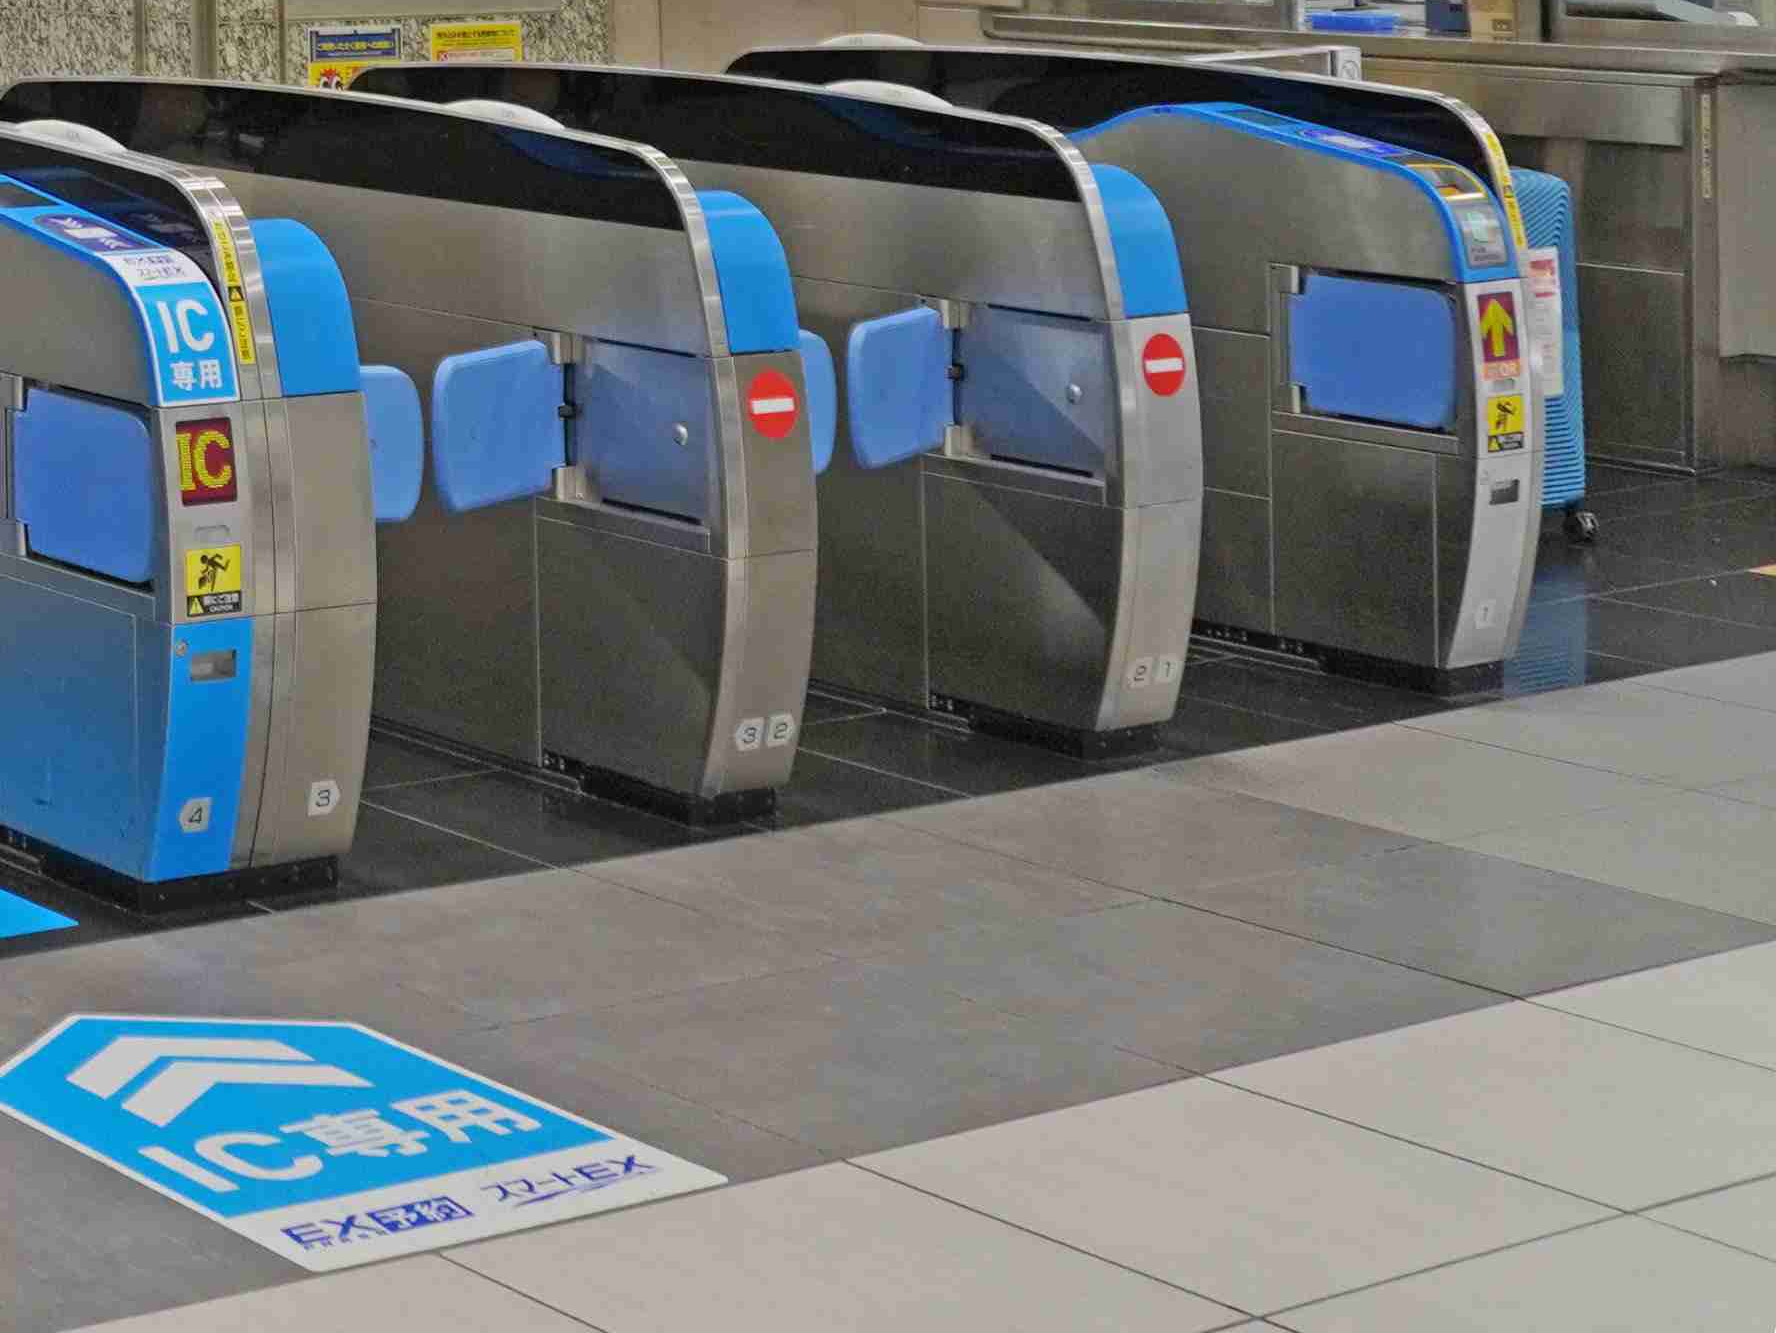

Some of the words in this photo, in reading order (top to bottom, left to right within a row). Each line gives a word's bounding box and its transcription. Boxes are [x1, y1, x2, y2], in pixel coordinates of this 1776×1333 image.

[157, 298, 215, 354] IC
[170, 358, 223, 391] 専用
[176, 430, 233, 492] IC
[743, 727, 757, 744] 3
[774, 723, 788, 740] 2
[315, 789, 332, 807] 3
[188, 806, 204, 823] 4
[137, 1090, 546, 1193] IC専用
